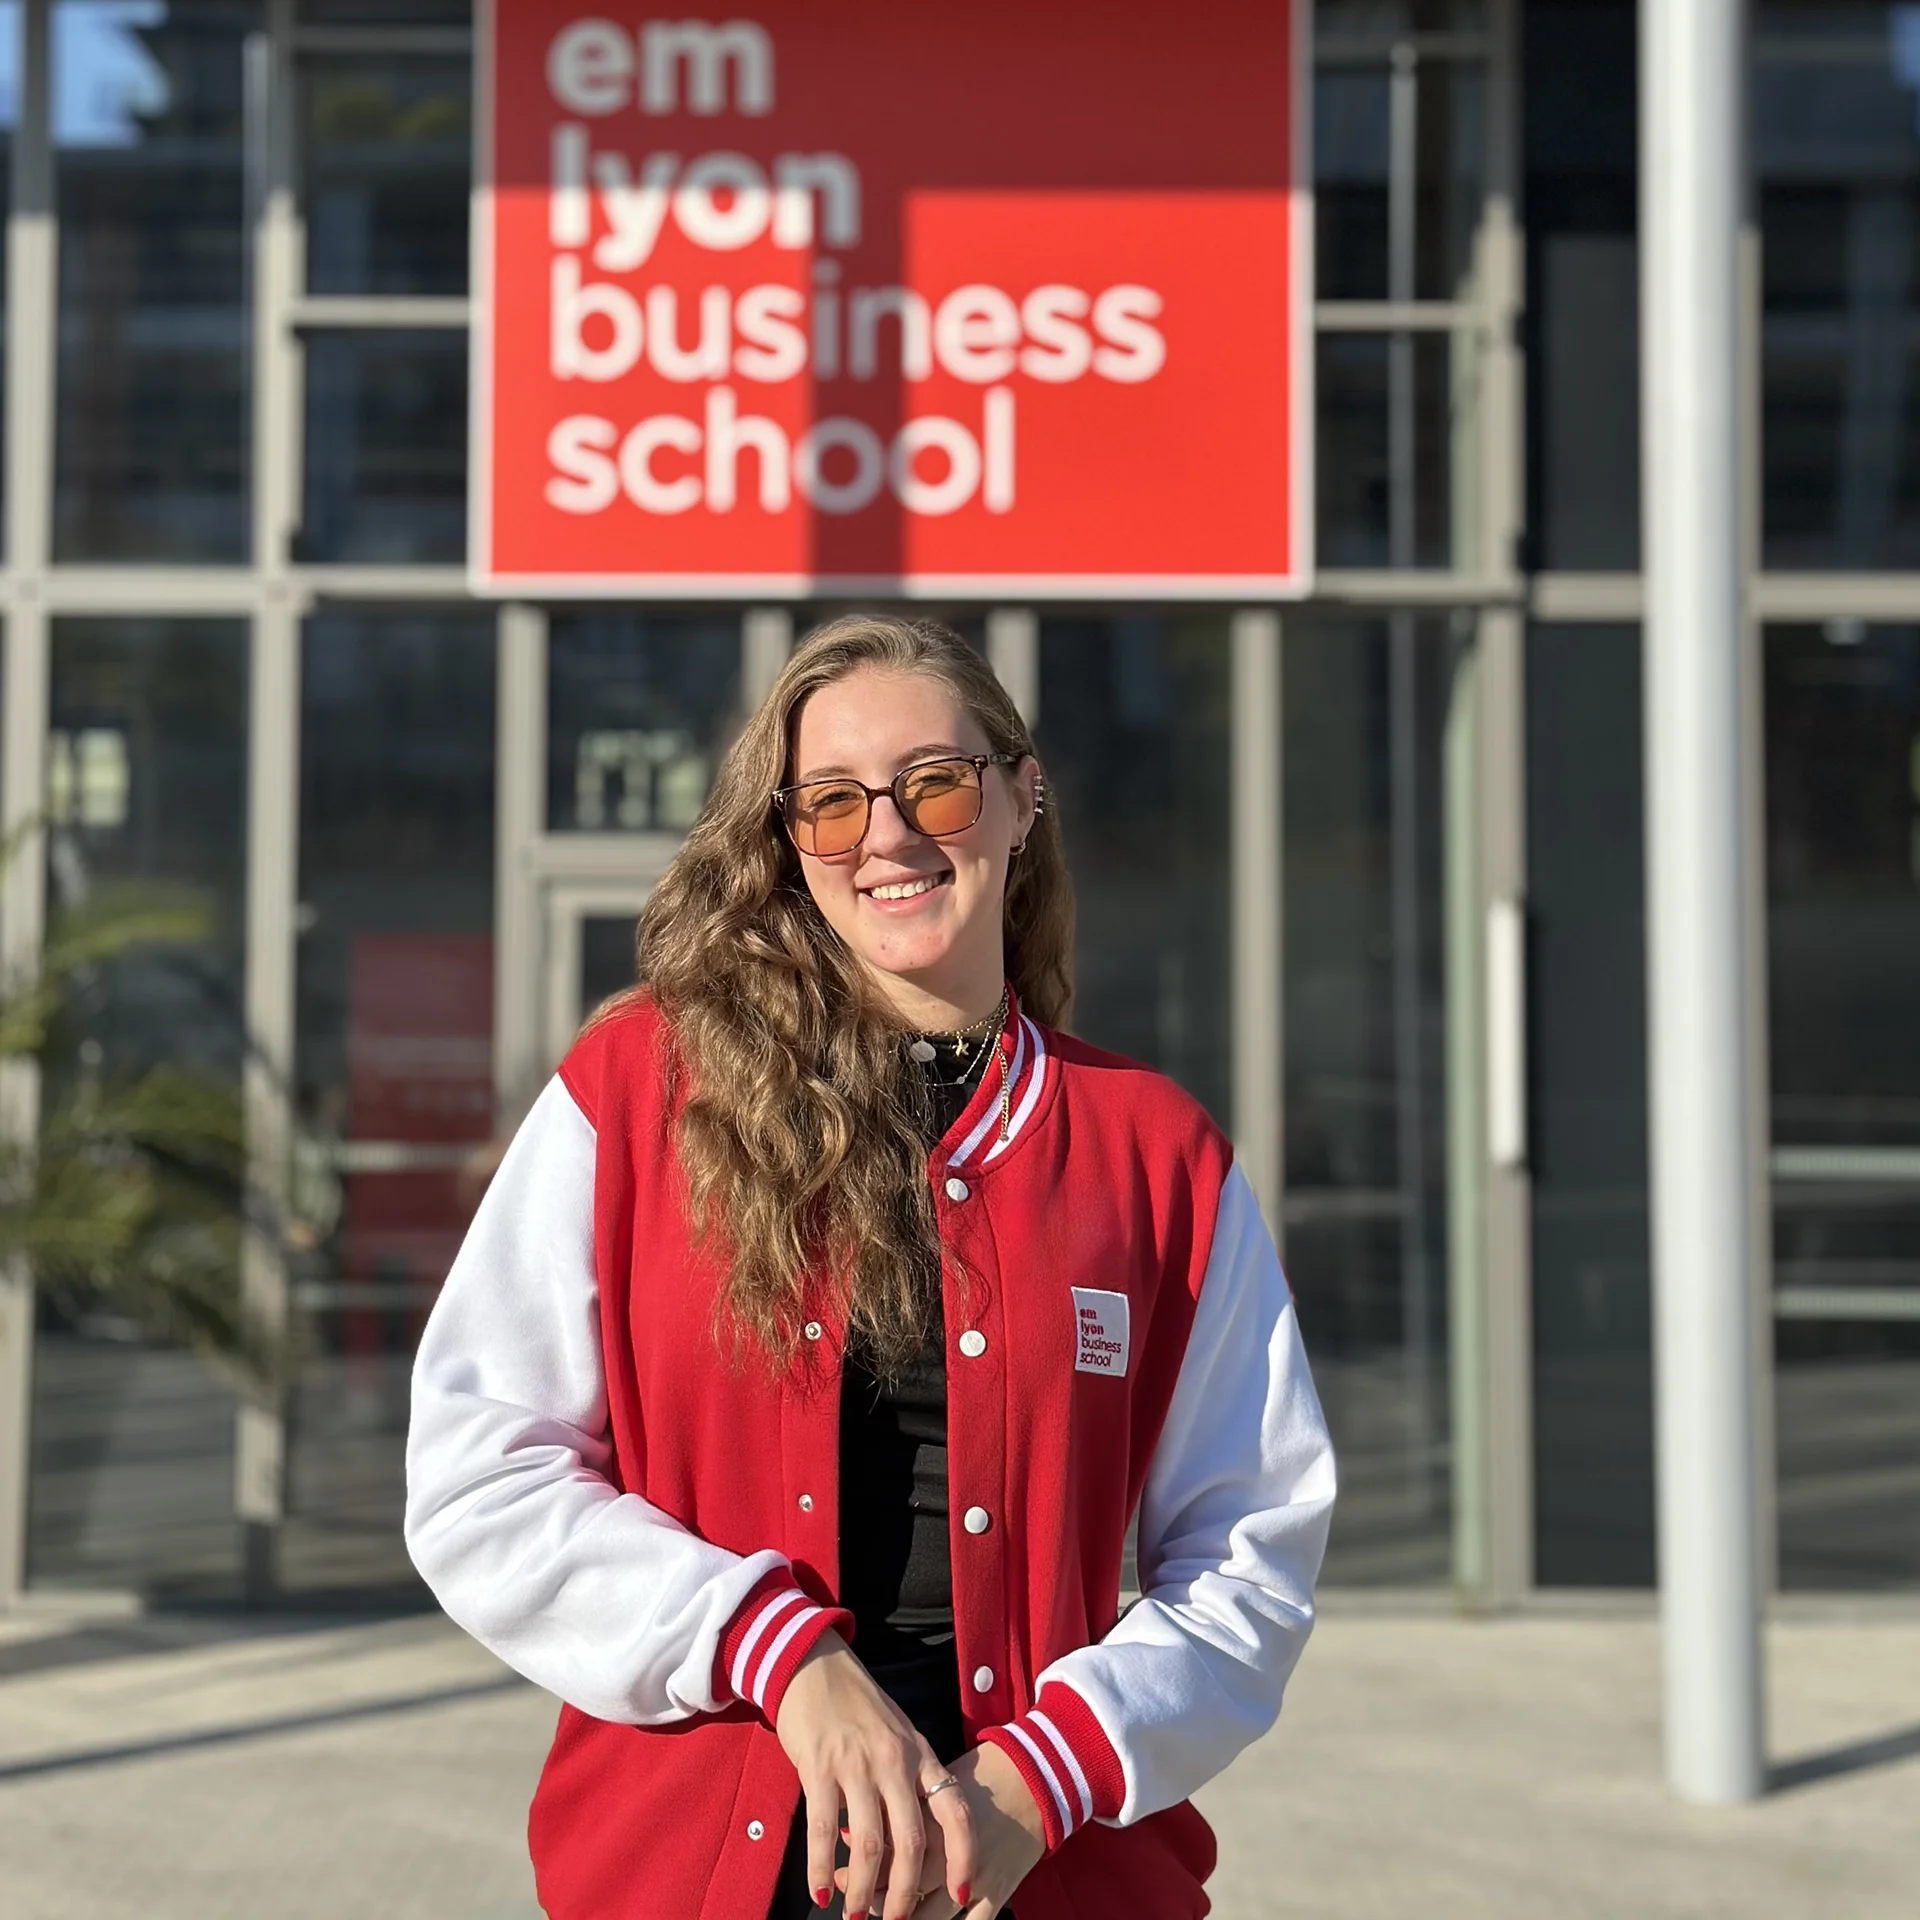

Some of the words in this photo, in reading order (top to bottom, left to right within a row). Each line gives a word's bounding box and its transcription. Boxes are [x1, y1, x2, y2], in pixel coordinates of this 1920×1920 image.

[548, 18, 774, 117] em
[549, 123, 861, 272] lyon
[550, 254, 1167, 383] business
[545, 386, 1016, 516] school
[1080, 1308, 1096, 1319] em
[1081, 1319, 1104, 1336] lyon
[1080, 1351, 1111, 1367] school
[1082, 1335, 1121, 1353] business
